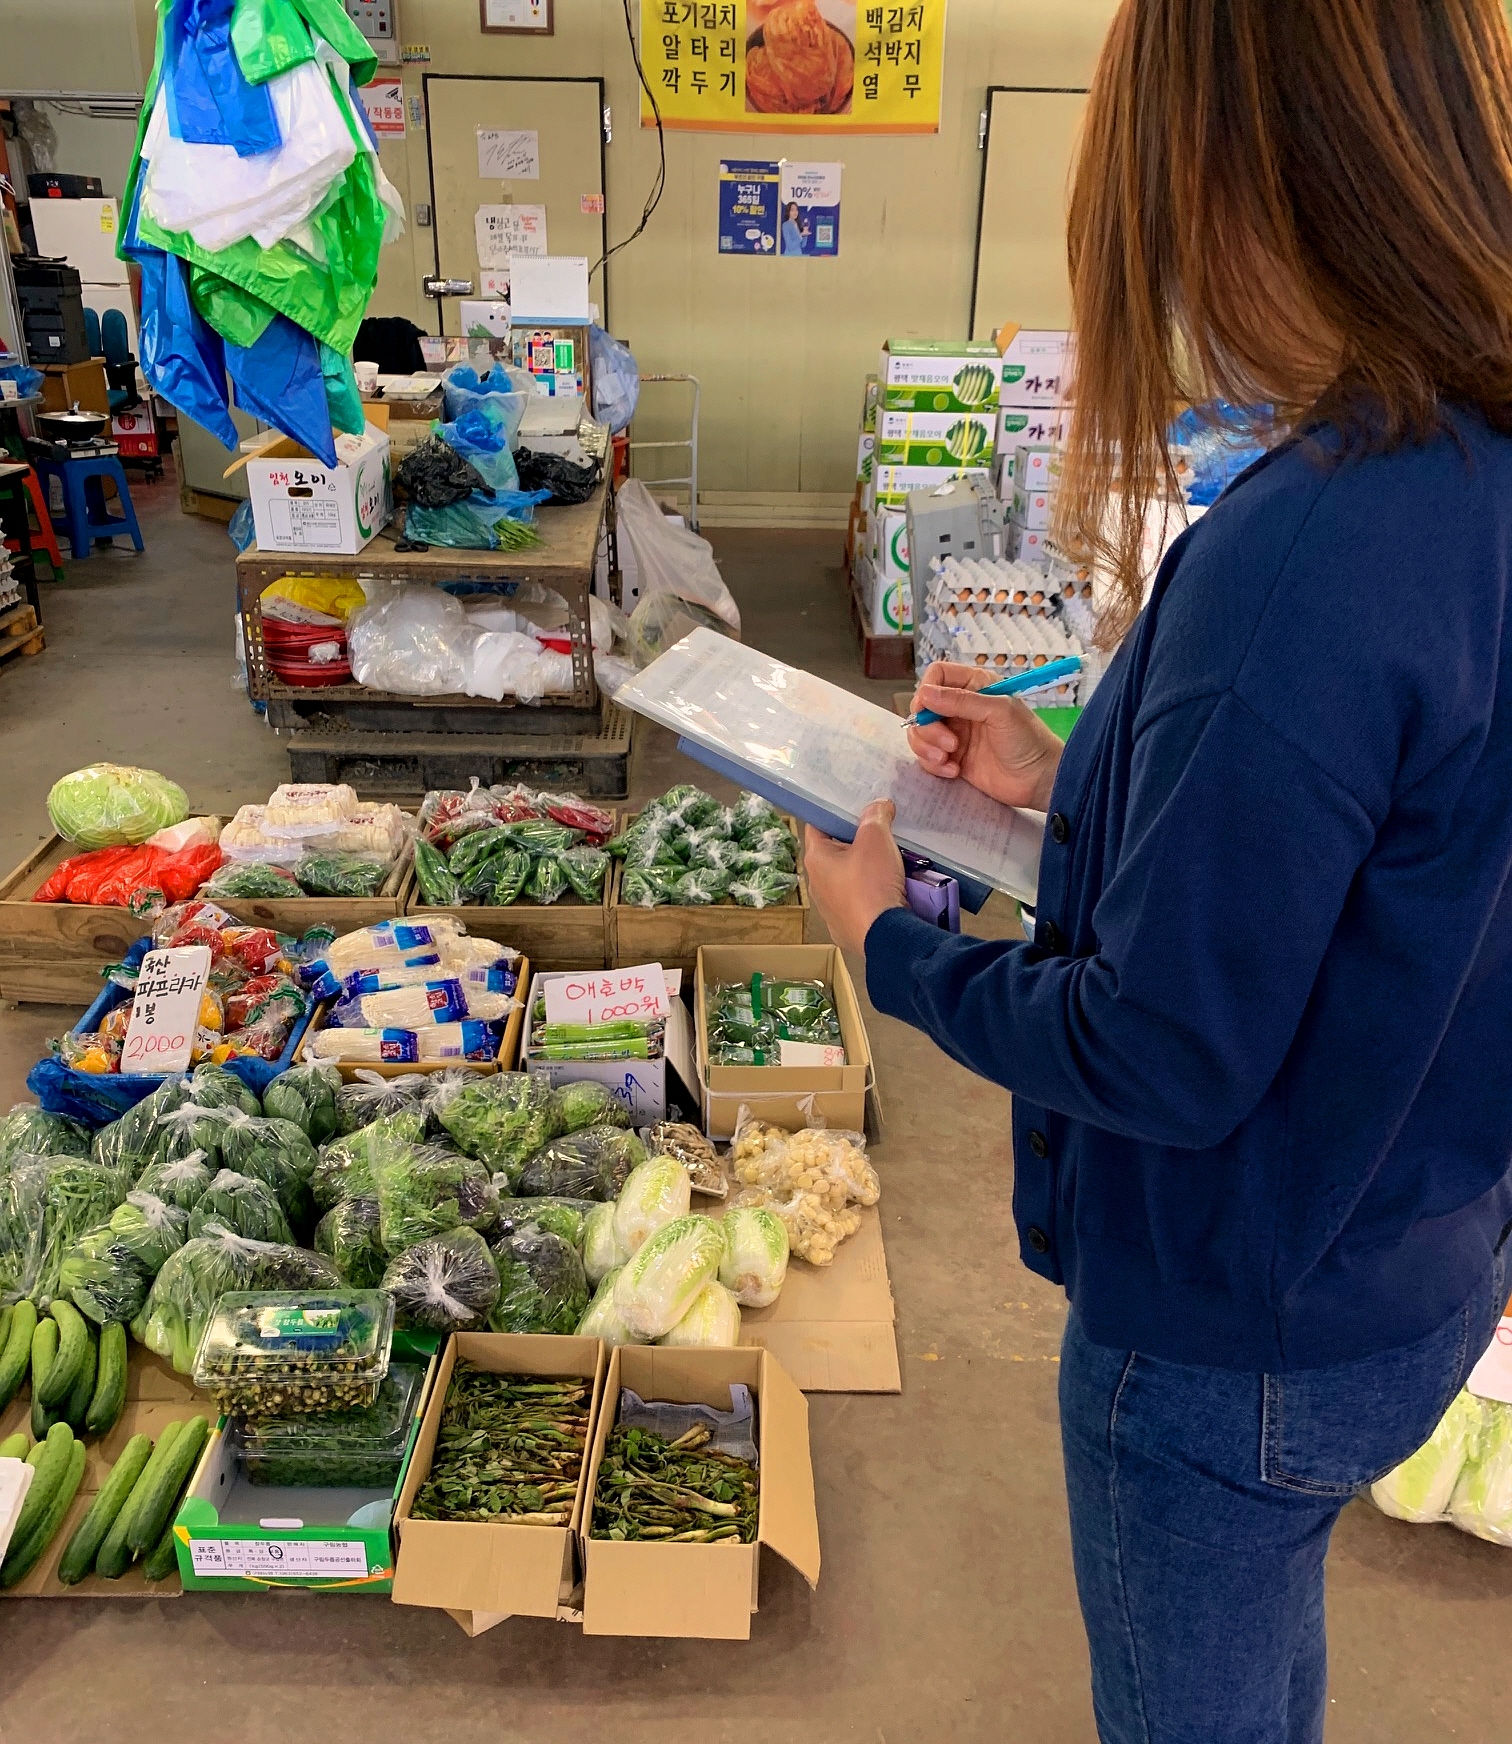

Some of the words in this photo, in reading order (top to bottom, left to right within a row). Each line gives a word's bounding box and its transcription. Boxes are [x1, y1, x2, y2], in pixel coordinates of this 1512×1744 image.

[662, 2, 736, 30] 포기김치
[866, 5, 924, 34] 백김치
[864, 40, 921, 67] 석박지
[373, 107, 402, 119] 작동중
[791, 187, 813, 199] 10%
[1025, 375, 1060, 395] 가지
[295, 470, 326, 485] 오이
[137, 975, 202, 998] 파프리카
[566, 977, 645, 1000] 애호박
[145, 1003, 156, 1024] 봉
[128, 1035, 185, 1060] 2,000
[198, 1546, 216, 1554] 표준
